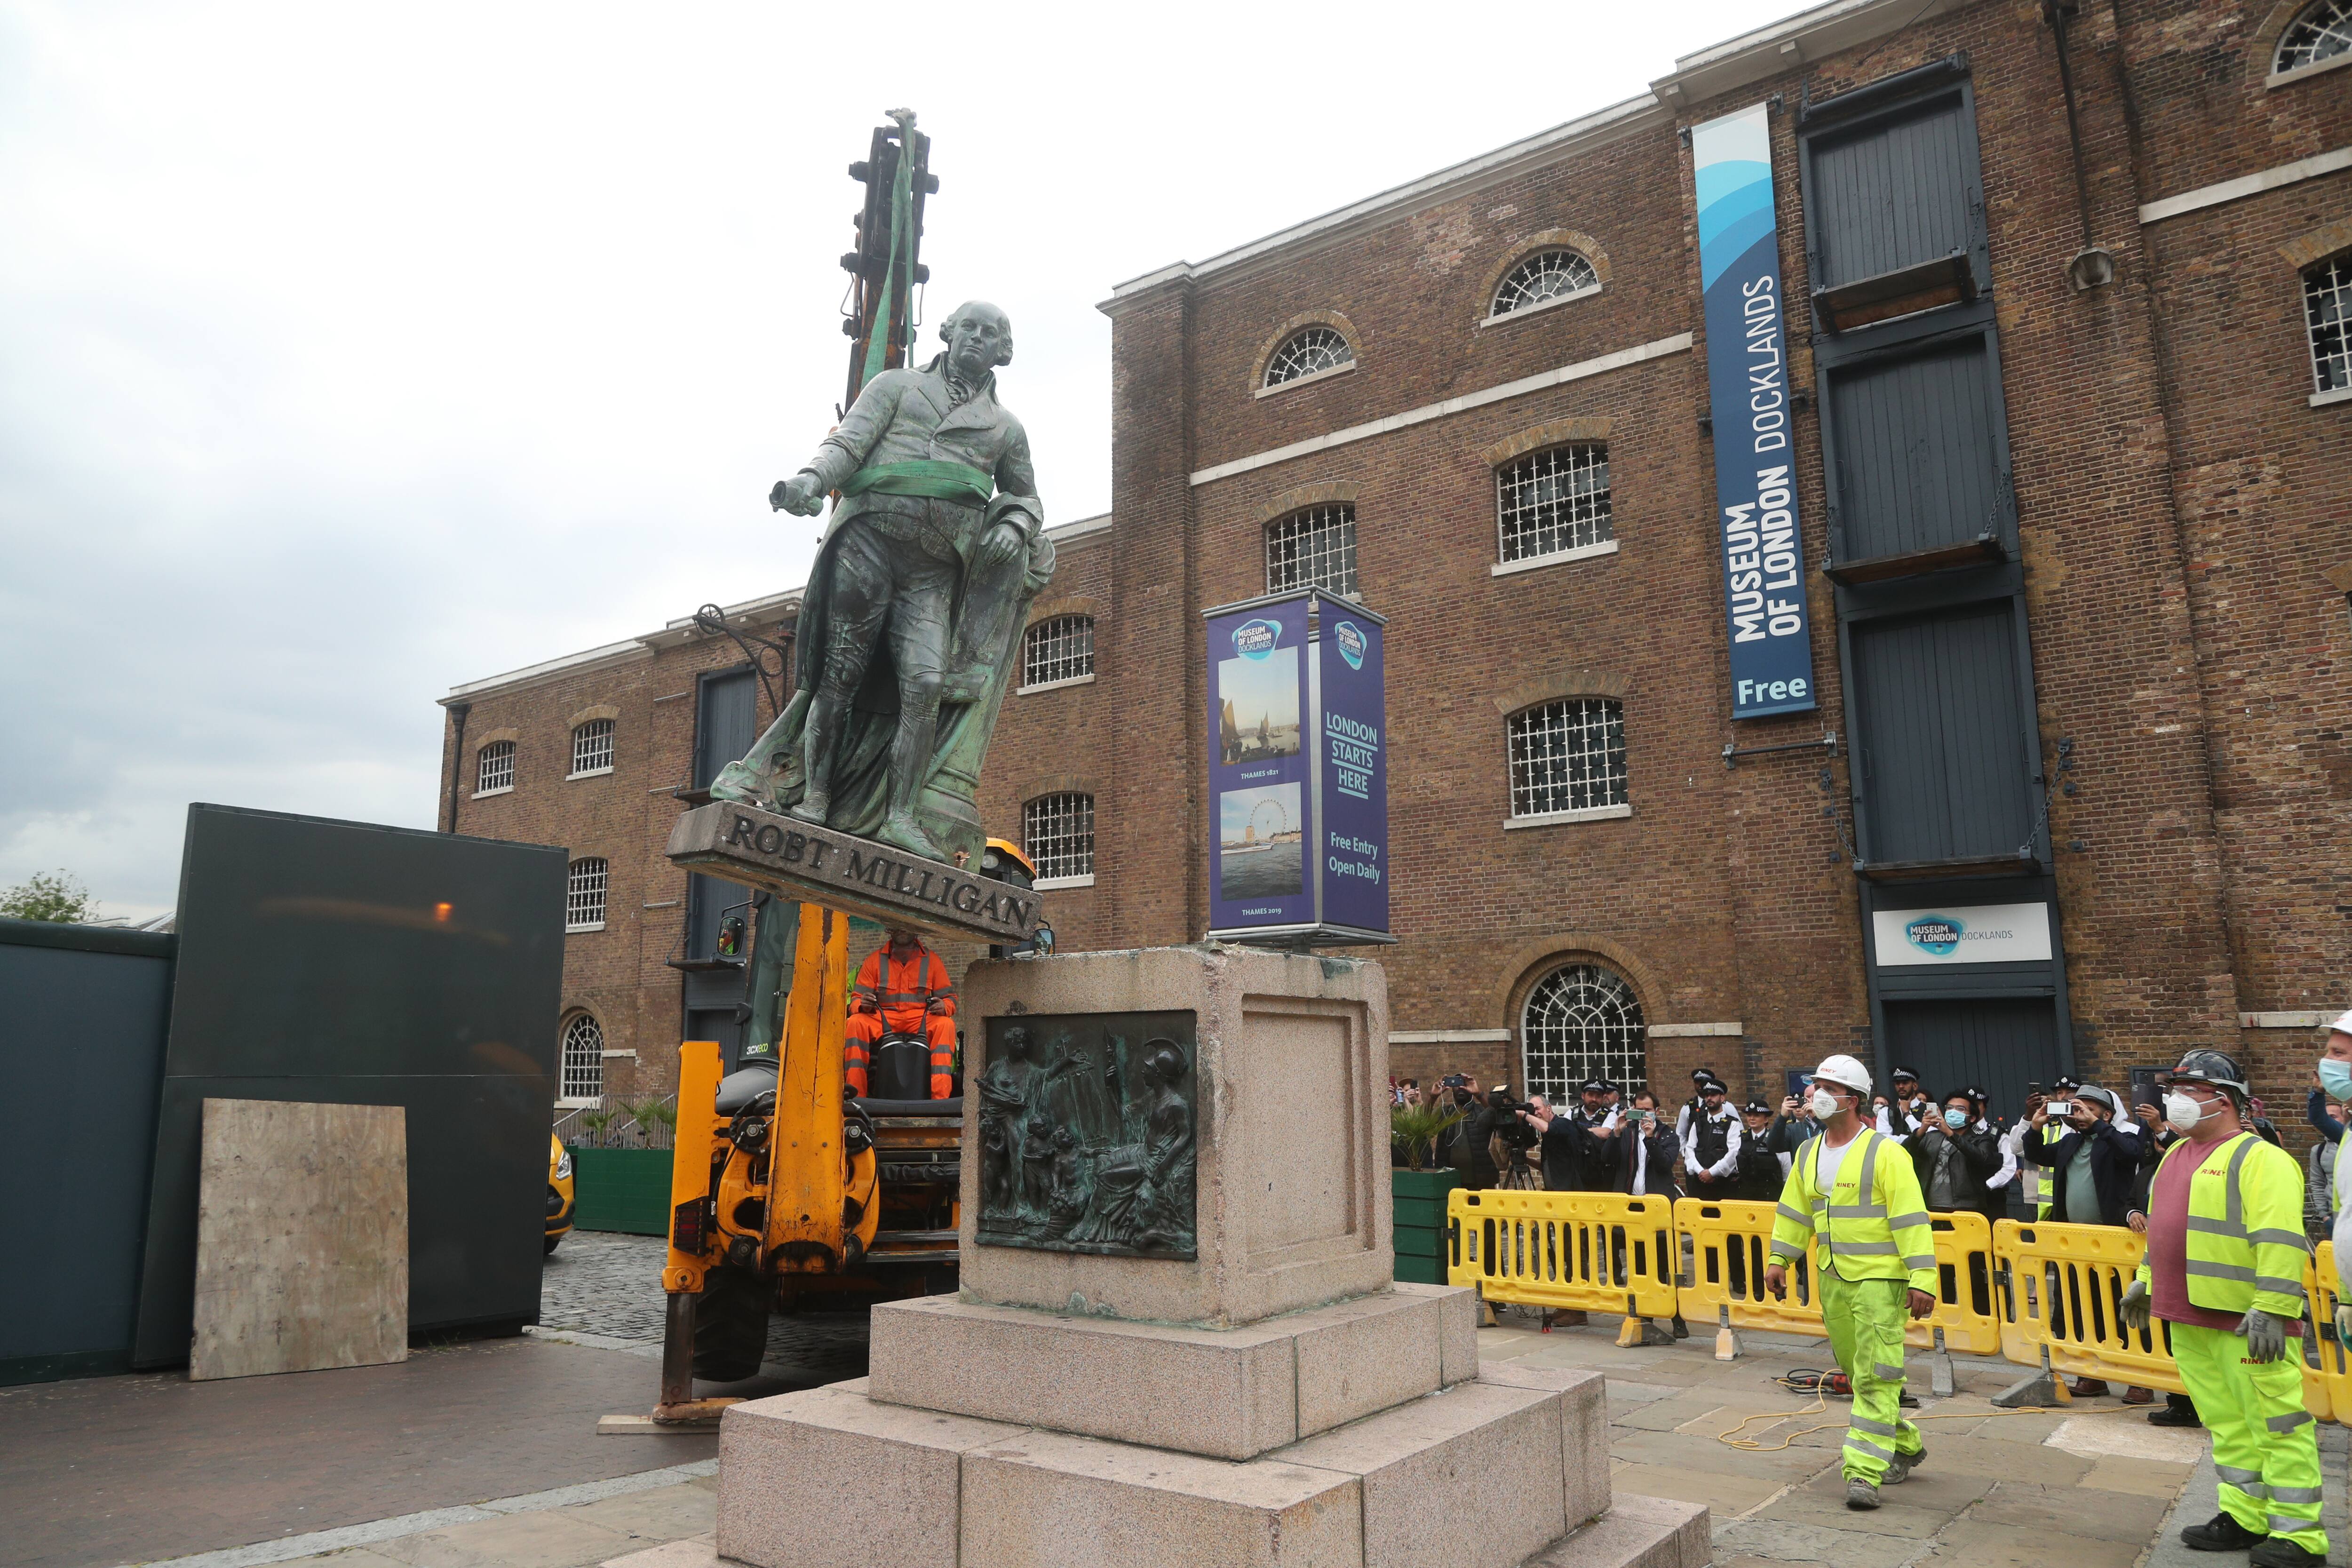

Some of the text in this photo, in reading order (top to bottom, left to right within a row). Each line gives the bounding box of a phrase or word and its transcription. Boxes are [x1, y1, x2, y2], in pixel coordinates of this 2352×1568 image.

[1742, 275, 1801, 637] OF LONDON DOCKLANDS
[1725, 501, 1766, 643] MUSEUM
[1238, 626, 1265, 638] MUSEUM
[1238, 632, 1271, 646] OF LONDON
[1339, 626, 1357, 639] MUSEUM
[1238, 640, 1271, 653] DOCKLANDS
[1339, 642, 1361, 656] DOCKLANDS
[1344, 635, 1360, 649] LONDON
[1738, 678, 1807, 705] Free
[1326, 712, 1377, 744] LONDON
[1332, 740, 1373, 768] STARTS
[1241, 770, 1265, 779] THAMES
[1338, 768, 1368, 792] HERE
[1331, 832, 1378, 860] Free Entry
[726, 814, 1033, 929] ROBT MILLIGAN
[1329, 856, 1380, 884] Open Daily
[1910, 925, 1948, 934] MUSEUM
[1923, 933, 1957, 942] LONDON
[1962, 931, 2013, 940] DOCKLANDS
